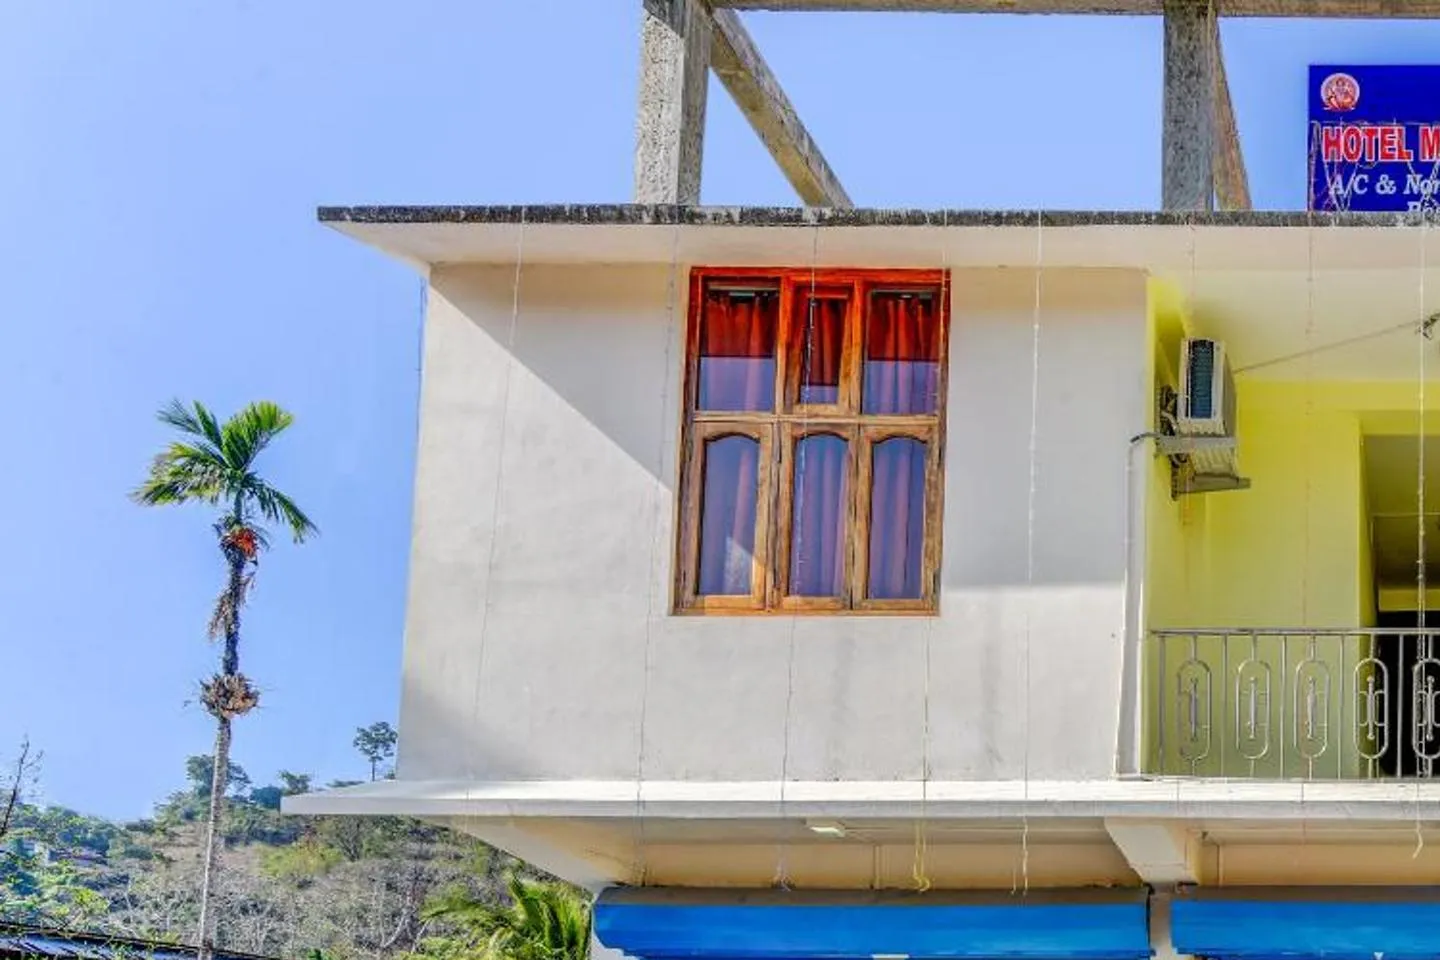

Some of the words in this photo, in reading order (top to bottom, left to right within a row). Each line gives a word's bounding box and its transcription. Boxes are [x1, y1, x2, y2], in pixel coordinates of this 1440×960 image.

[1322, 125, 1414, 162] HOTEL
[1330, 173, 1369, 199] A/C
[1375, 174, 1397, 195] &
